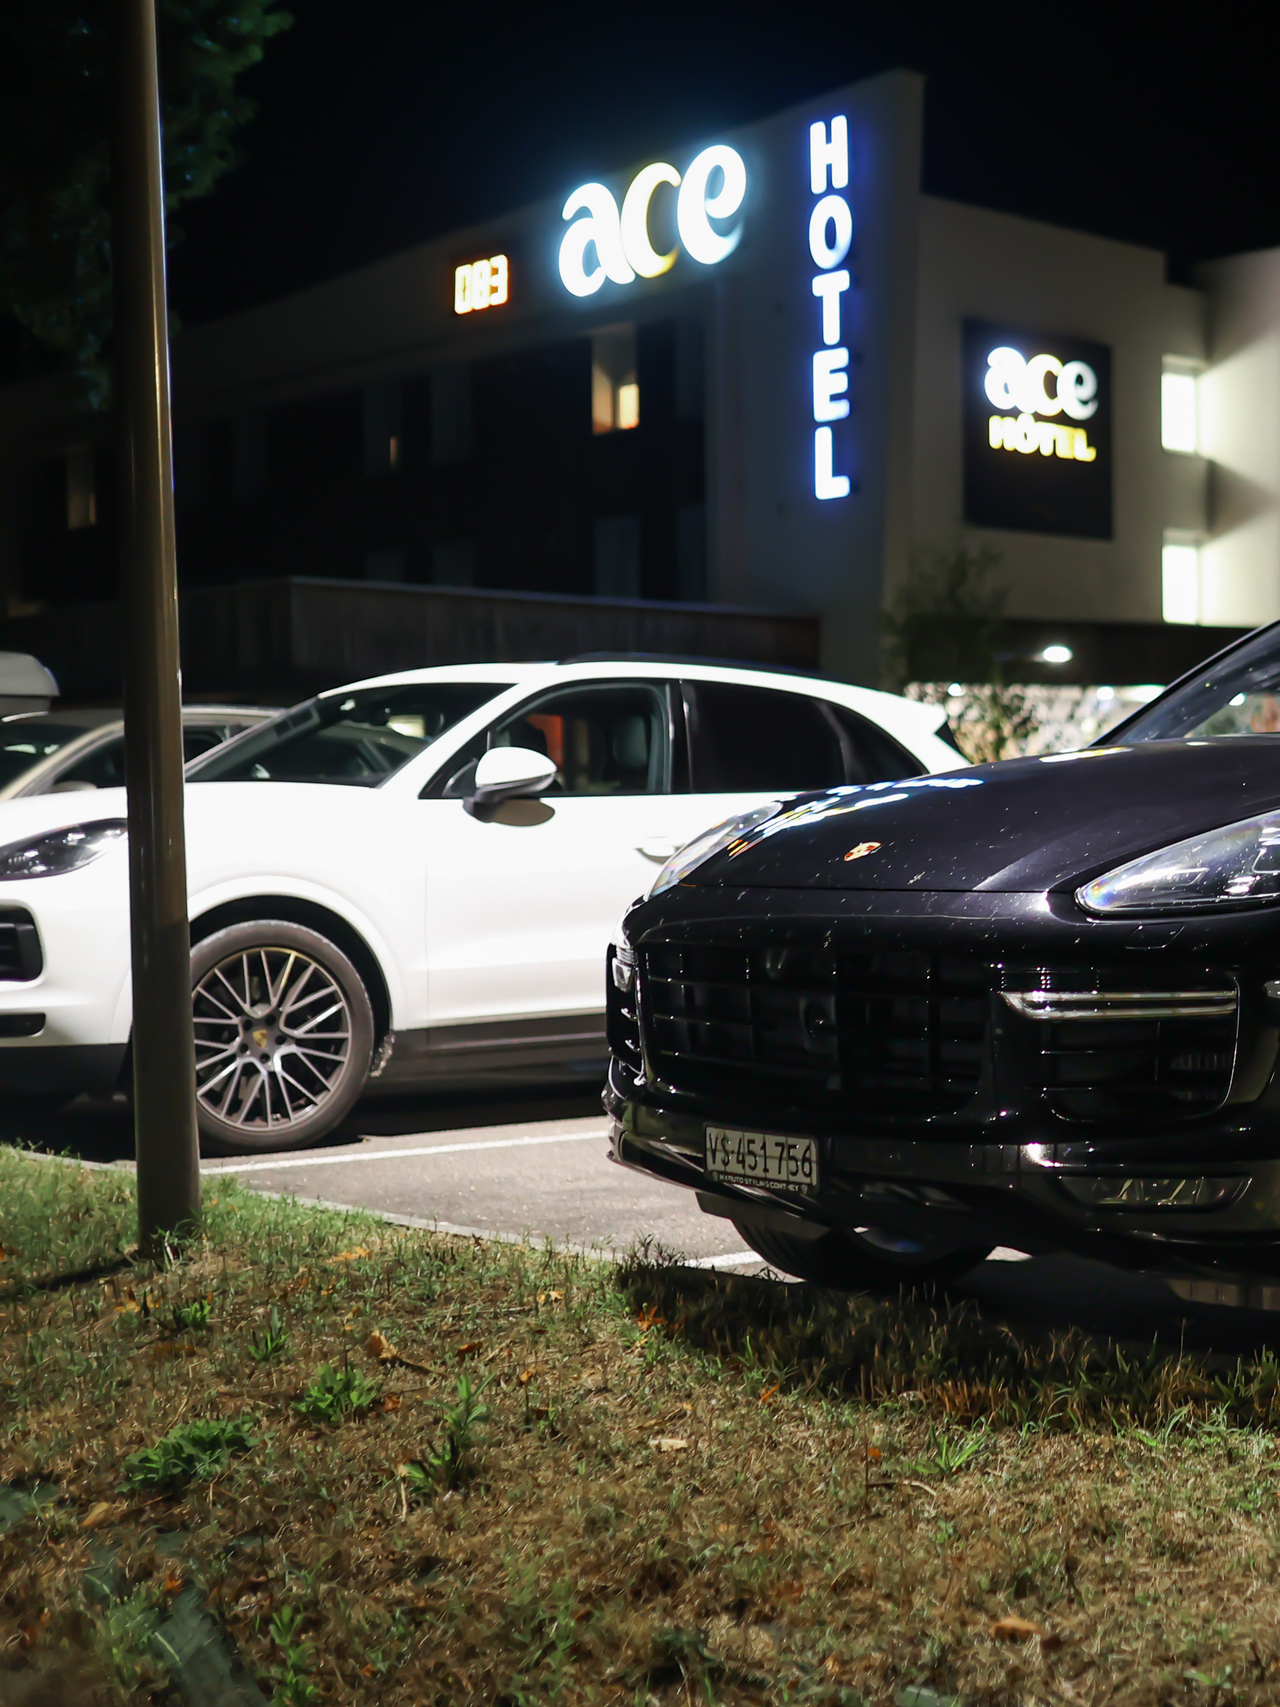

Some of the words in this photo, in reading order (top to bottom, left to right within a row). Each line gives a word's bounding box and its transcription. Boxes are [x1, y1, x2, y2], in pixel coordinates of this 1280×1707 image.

[558, 144, 747, 298] ace
[809, 114, 852, 500] HOTEL
[984, 346, 1099, 421] ace
